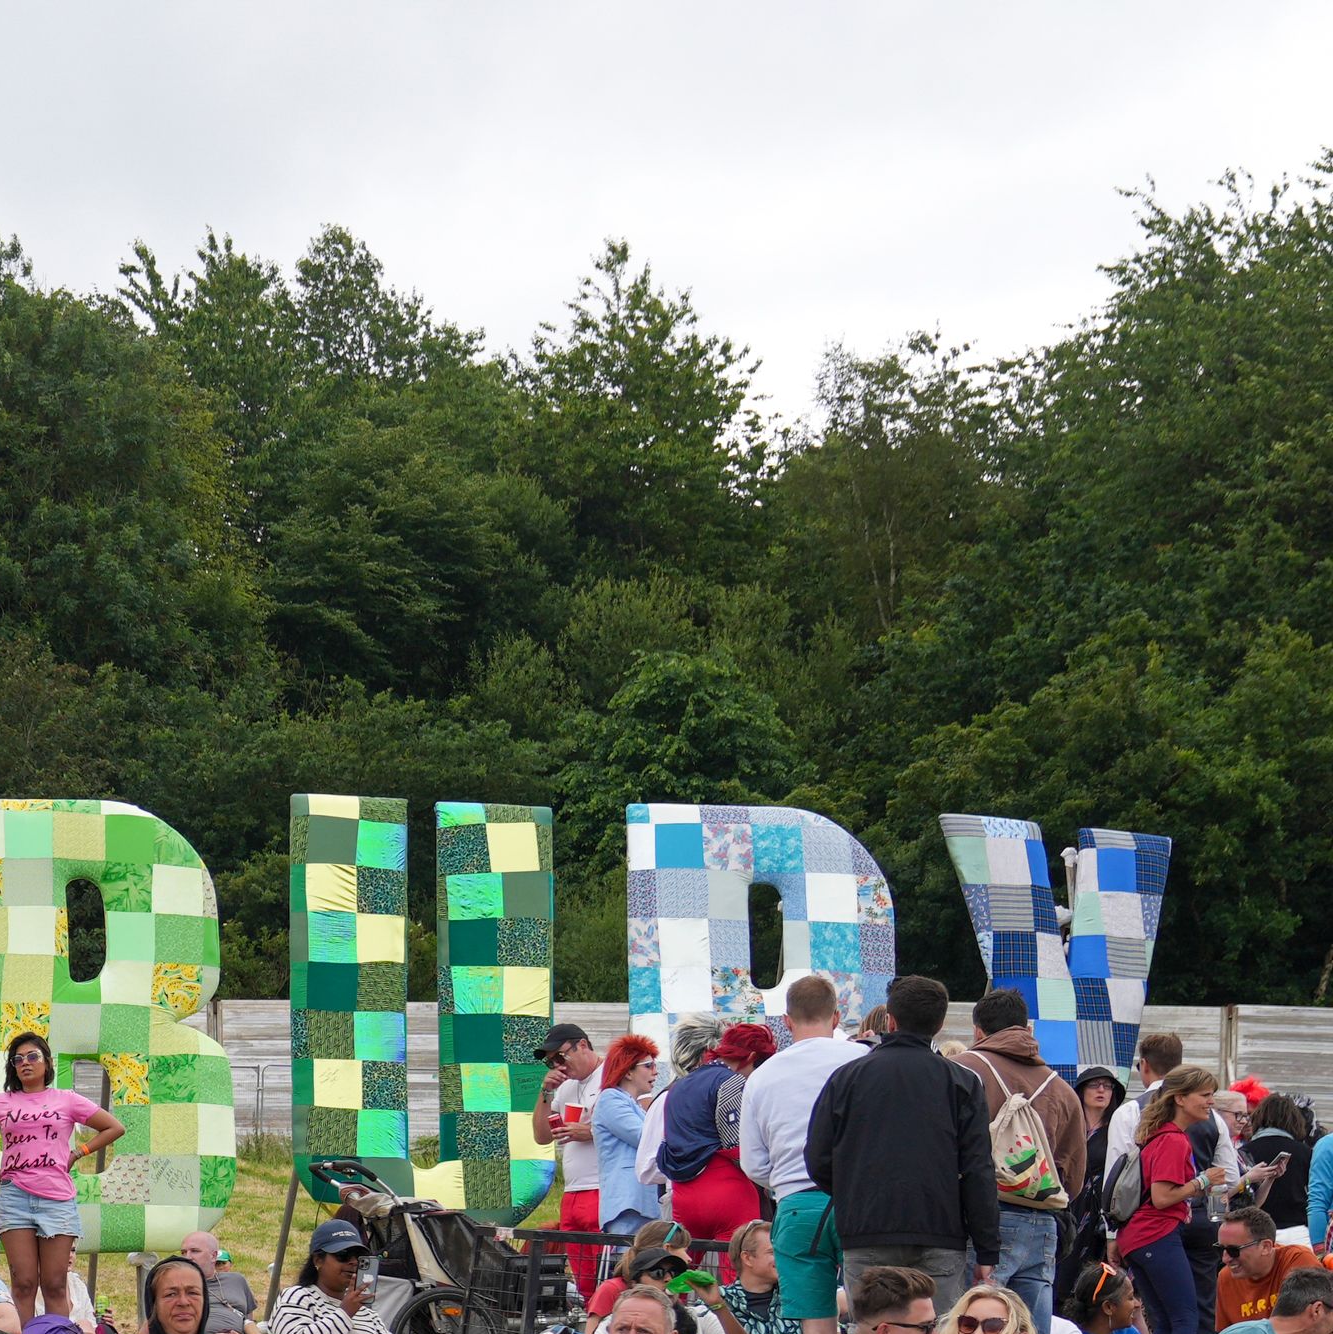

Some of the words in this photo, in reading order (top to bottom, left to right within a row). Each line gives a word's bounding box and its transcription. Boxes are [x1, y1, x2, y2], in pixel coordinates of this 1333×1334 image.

[5, 1109, 61, 1127] Never
[5, 1132, 37, 1150] Been
[43, 1124, 58, 1140] To
[4, 1152, 56, 1171] Glasto
